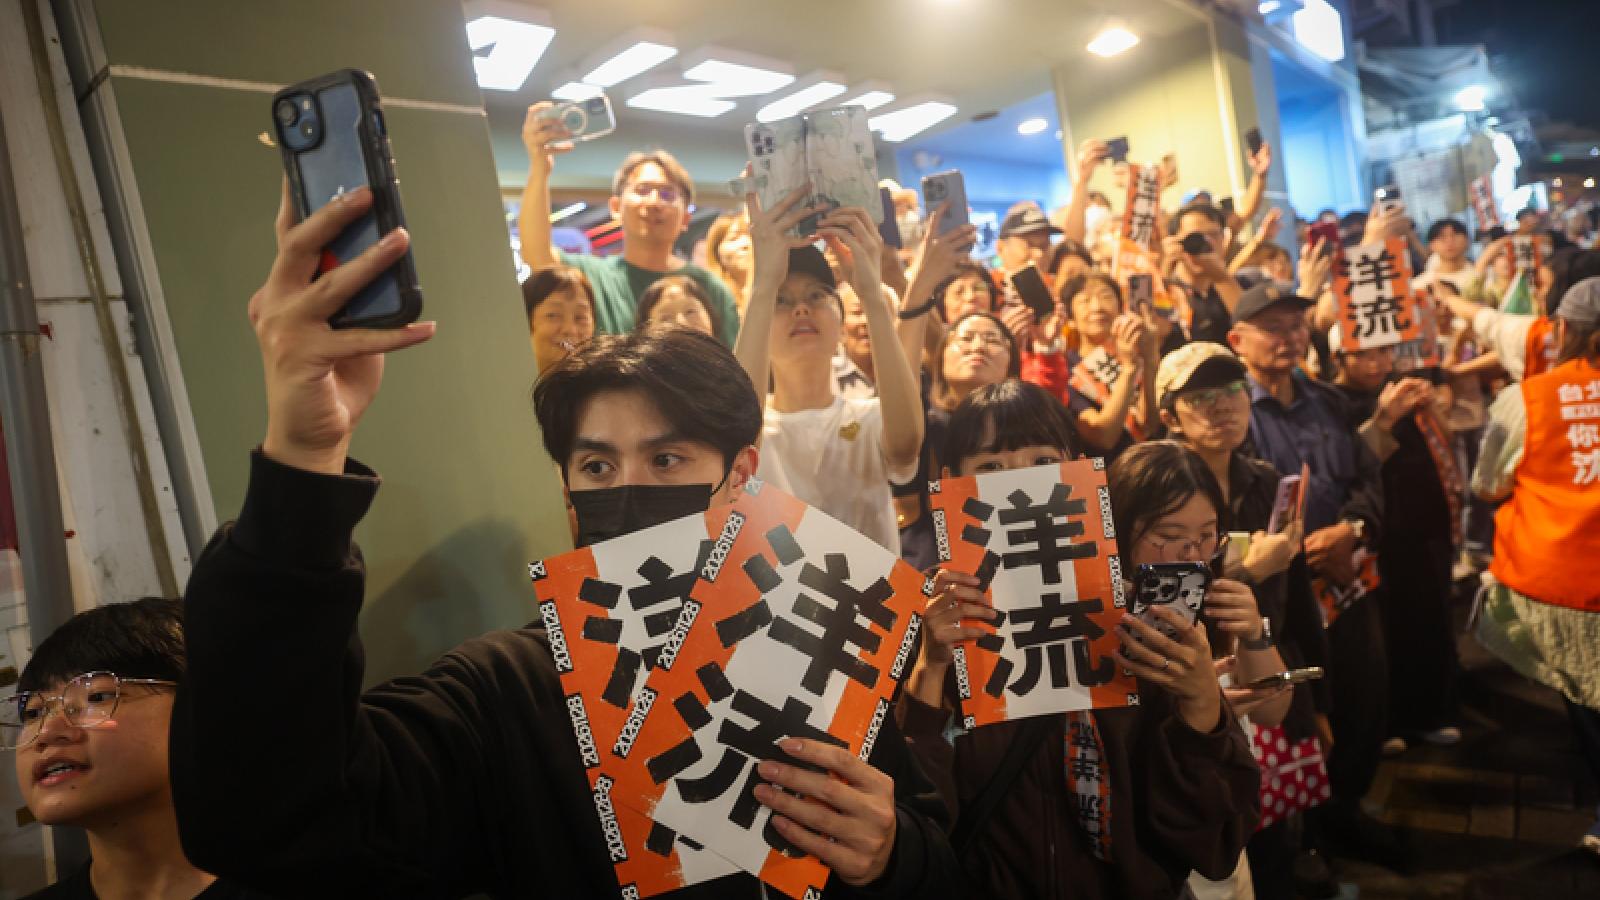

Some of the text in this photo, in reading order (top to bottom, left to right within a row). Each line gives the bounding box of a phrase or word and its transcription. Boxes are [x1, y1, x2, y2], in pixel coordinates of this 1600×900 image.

[1340, 249, 1406, 339] 洋流
[645, 523, 899, 857] 洋流
[961, 483, 1115, 698] 洋流
